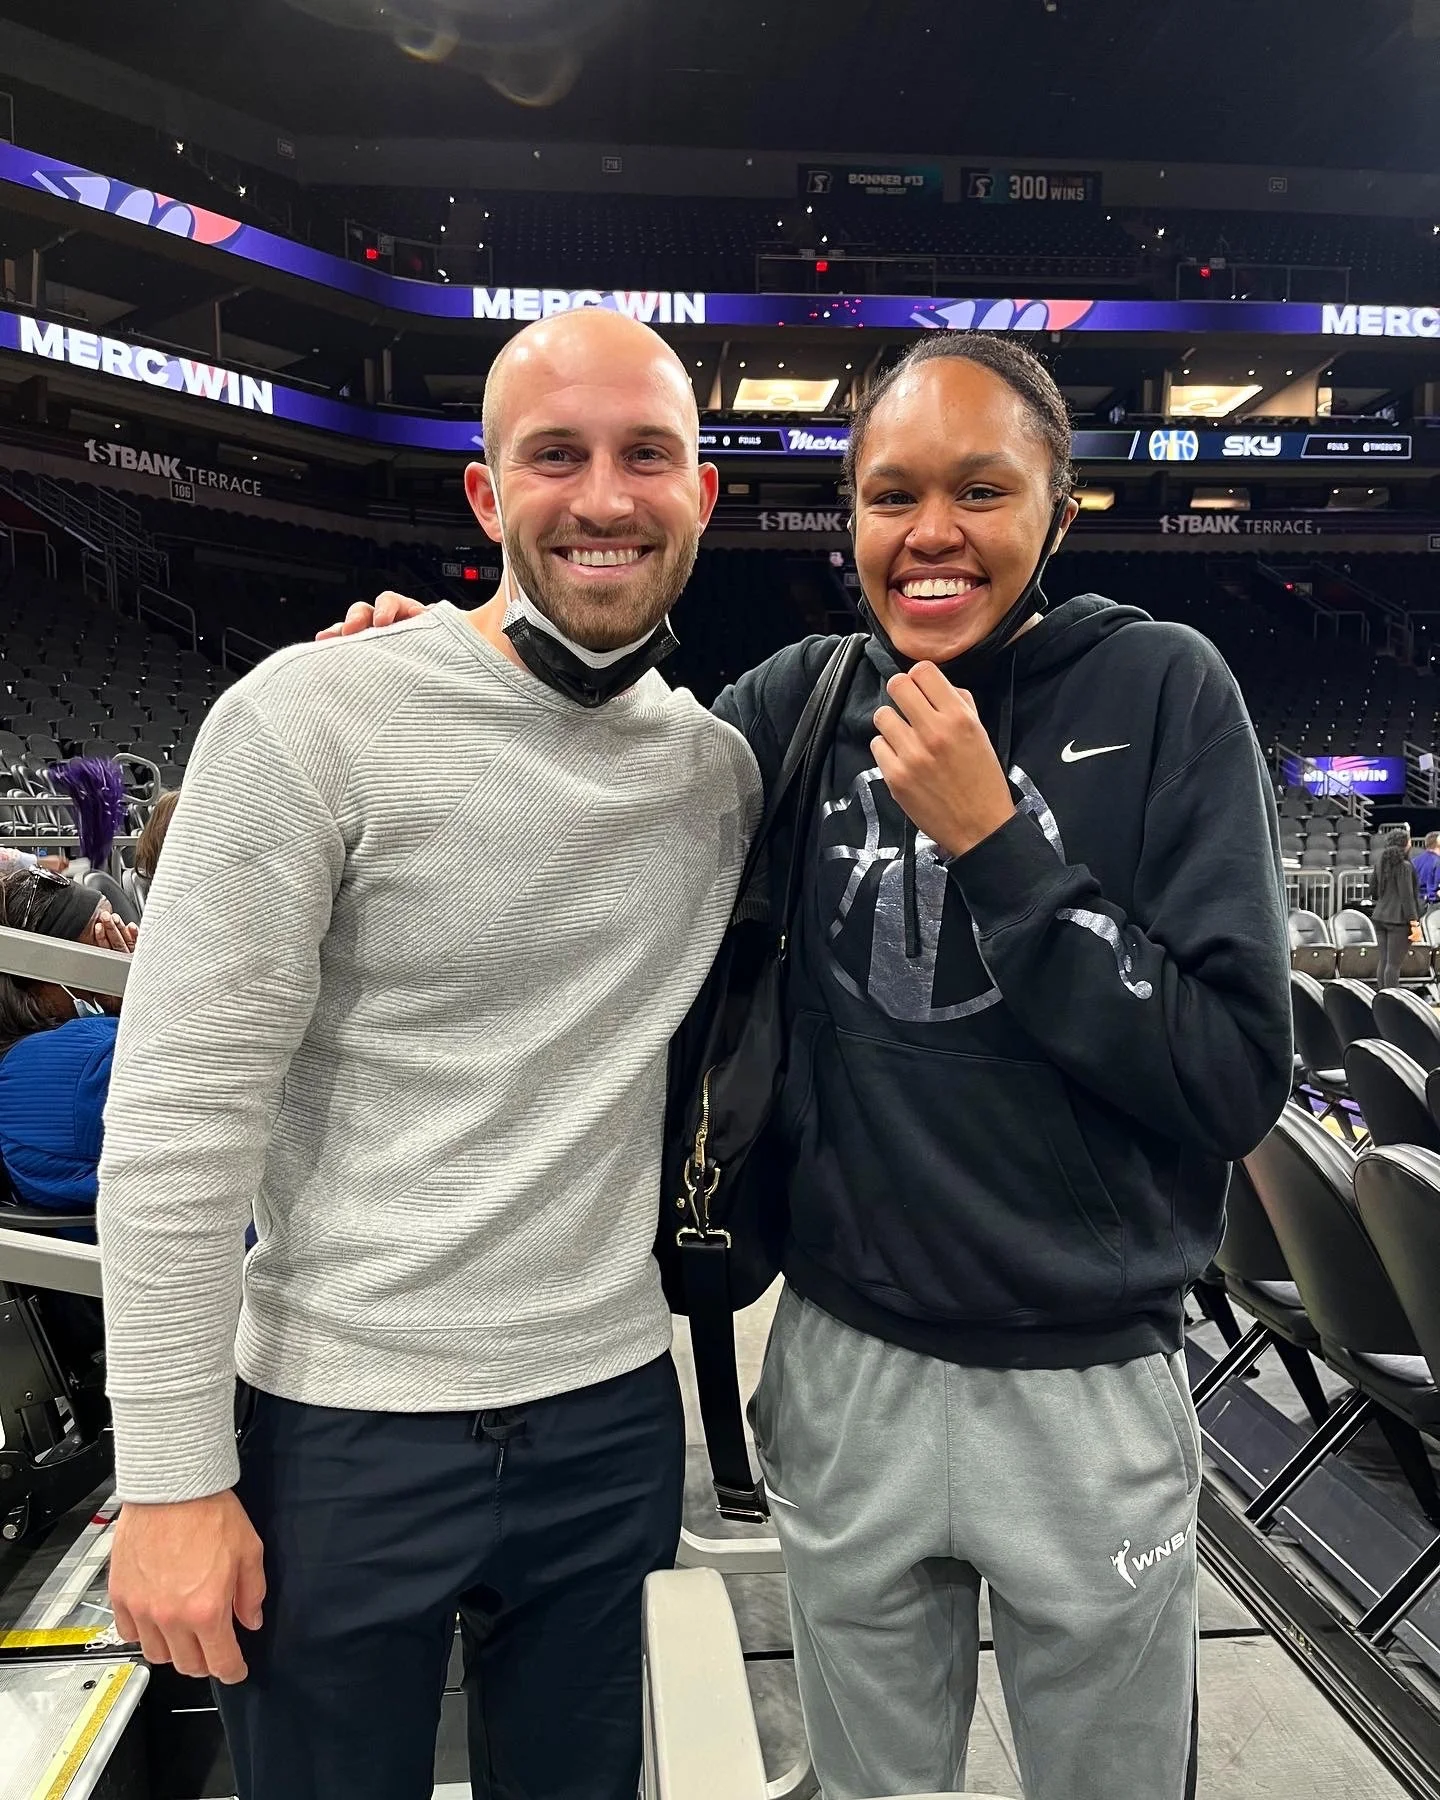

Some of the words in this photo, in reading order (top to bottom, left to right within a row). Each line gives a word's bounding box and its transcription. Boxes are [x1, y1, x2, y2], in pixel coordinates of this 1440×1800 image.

[1009, 175, 1047, 200] 300
[1051, 186, 1085, 201] WINS
[612, 290, 706, 323] WIN
[1322, 304, 1440, 338] MERC
[19, 315, 170, 387] MERC
[177, 357, 274, 415] WIN
[788, 429, 850, 450] Merc
[1222, 435, 1281, 457] SKY
[186, 465, 263, 497] TERRACE
[1244, 520, 1313, 534] TERRACE
[1353, 769, 1388, 782] WIN
